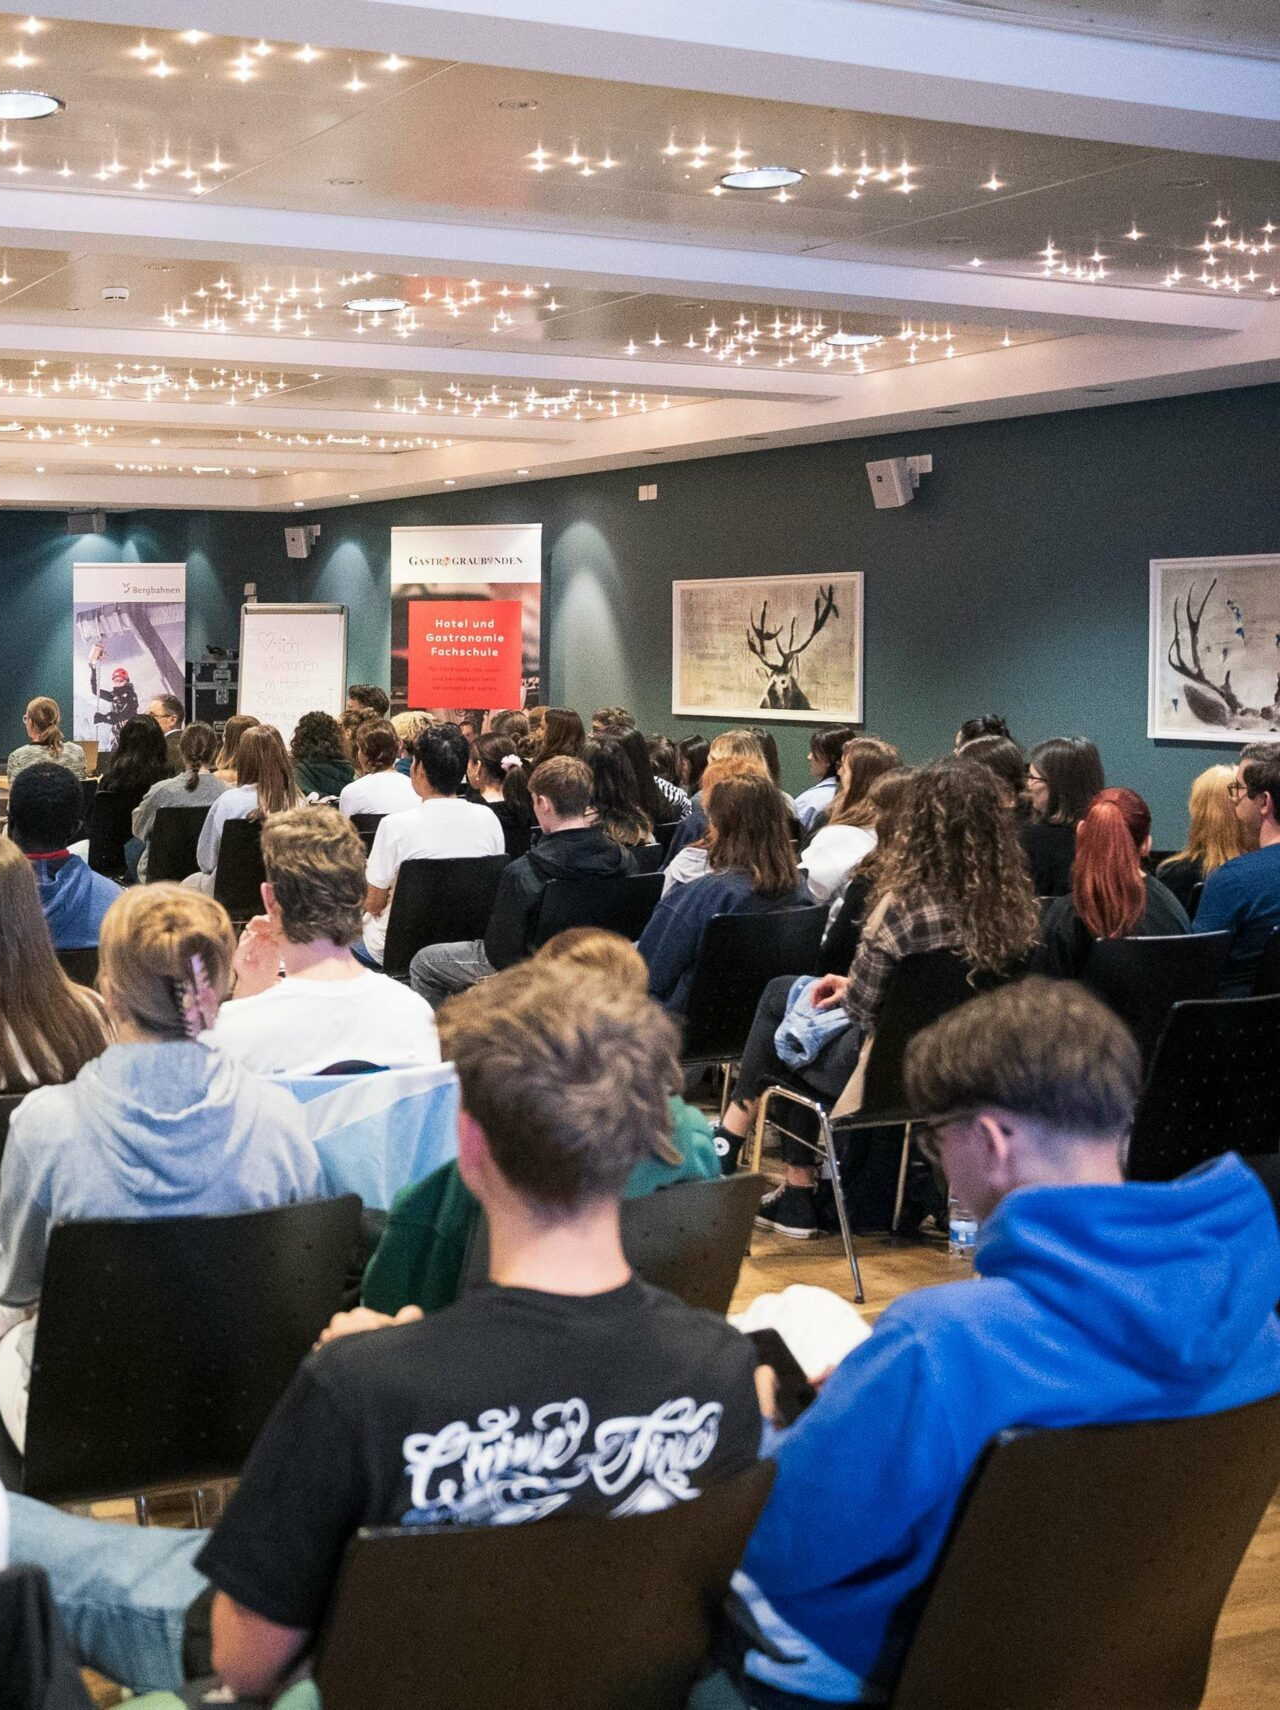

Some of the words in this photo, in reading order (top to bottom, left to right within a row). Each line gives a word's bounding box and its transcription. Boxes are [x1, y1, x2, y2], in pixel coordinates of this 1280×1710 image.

[132, 586, 181, 596] Bergbahnen
[435, 619, 468, 629] Hotel
[472, 619, 495, 629] und
[425, 633, 505, 643] Gastronomie
[430, 647, 499, 657] Fachschule
